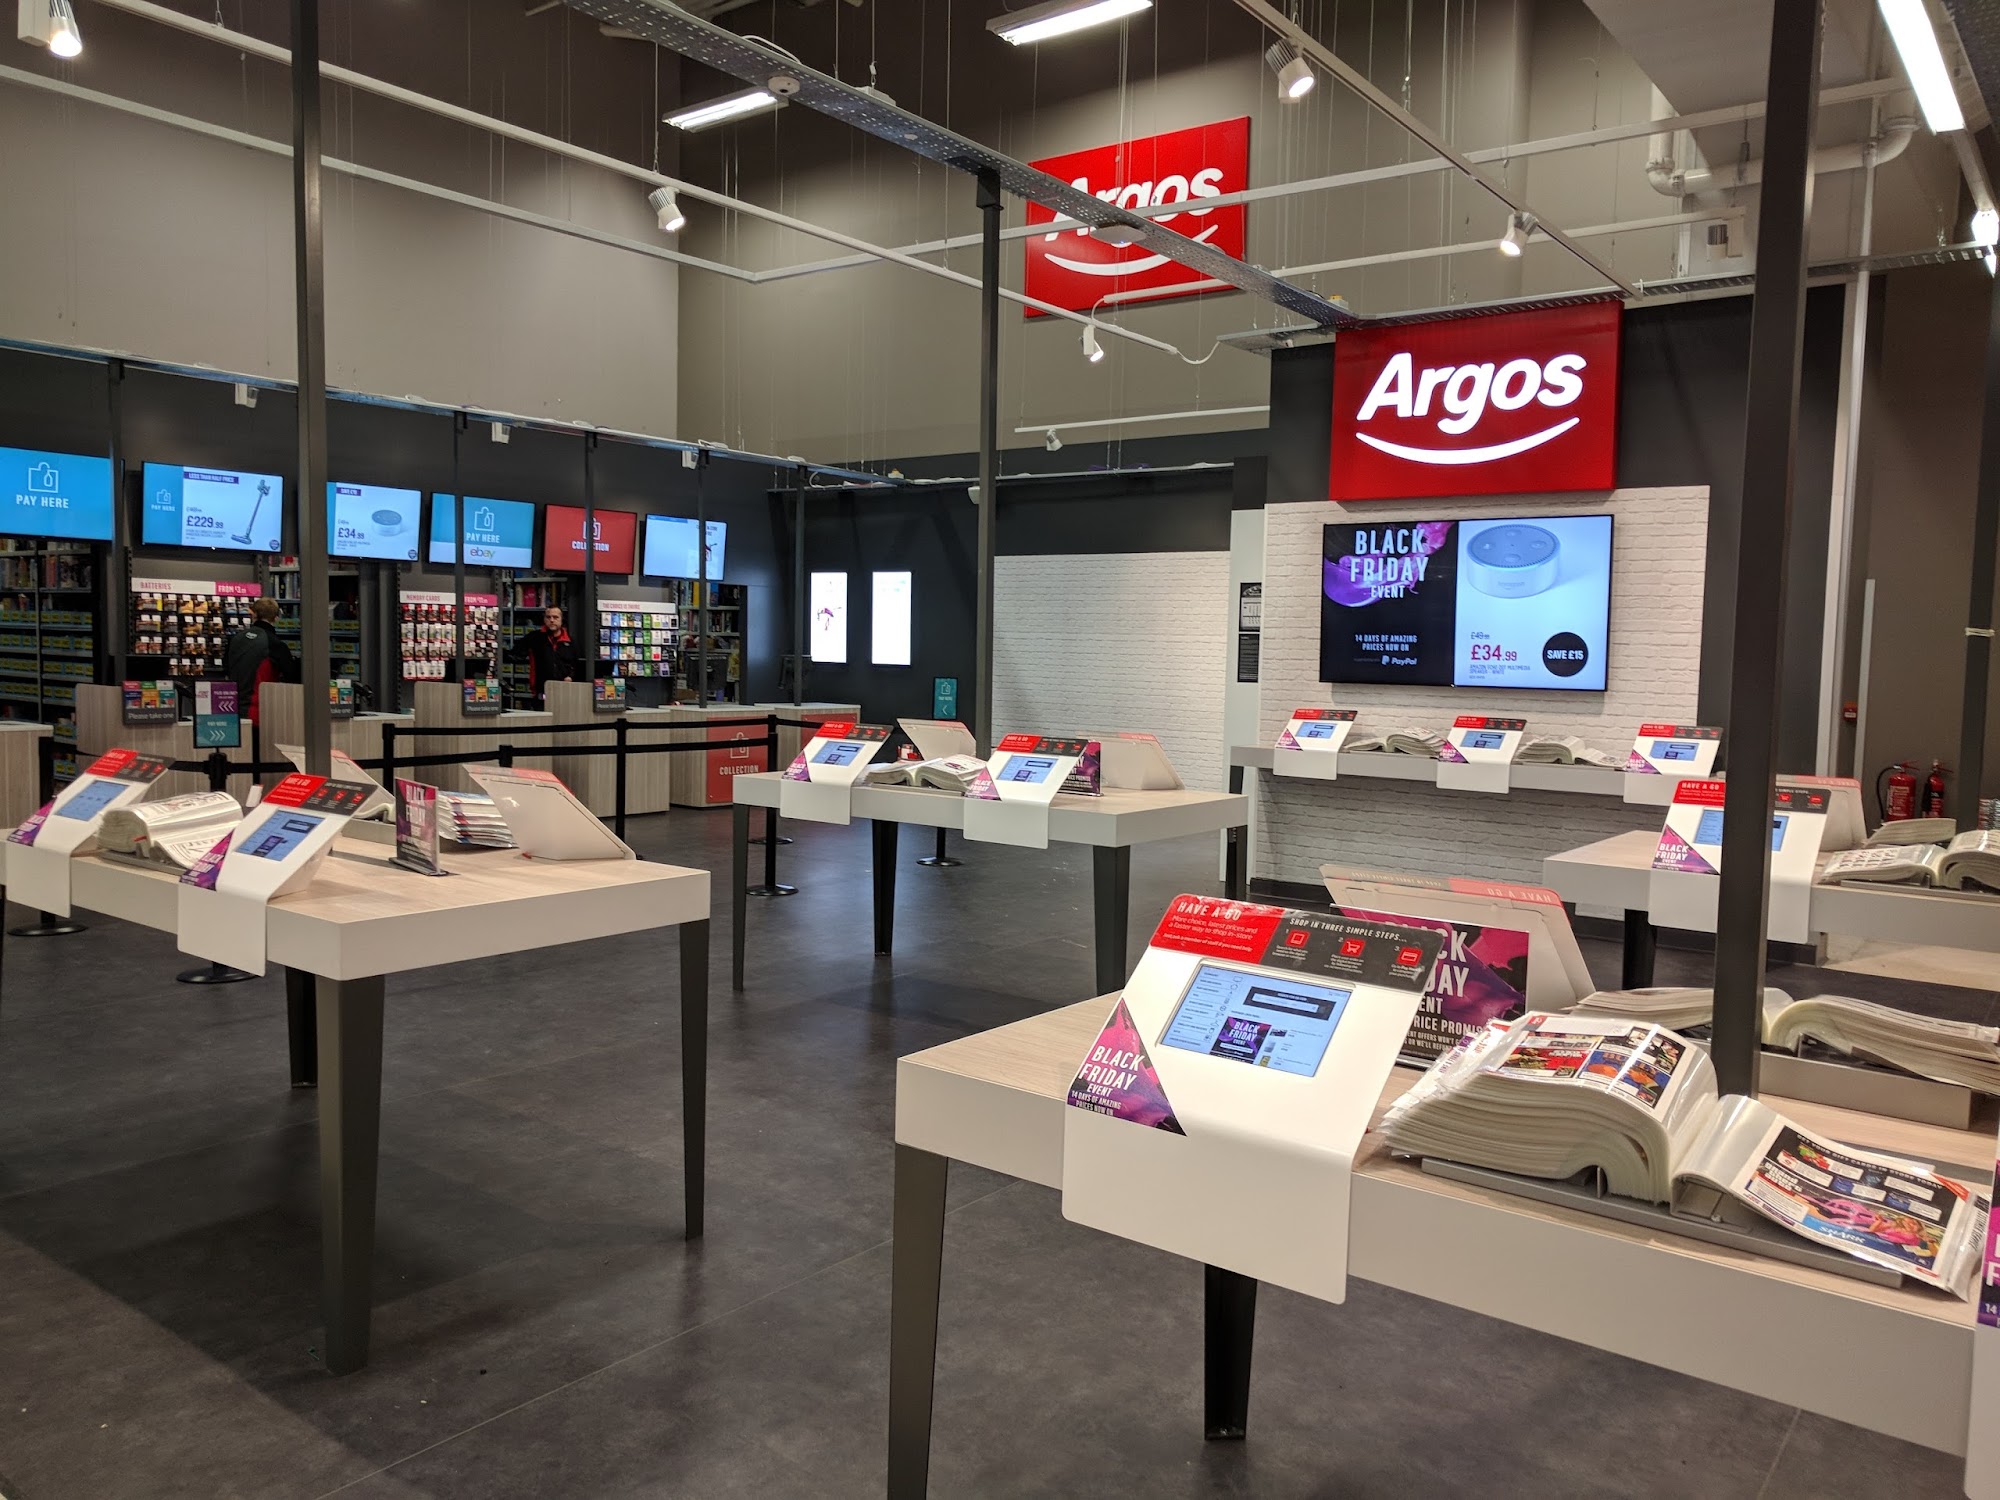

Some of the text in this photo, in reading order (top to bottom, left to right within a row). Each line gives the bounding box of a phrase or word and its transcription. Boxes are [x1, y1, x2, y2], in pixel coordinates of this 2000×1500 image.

[1356, 352, 1587, 434] Argos
[16, 495, 69, 509] PAY HERE
[186, 515, 224, 530] £229.99
[338, 527, 365, 540] £34.99
[466, 532, 500, 543] PAY HERE
[572, 540, 610, 552] COLLTION
[1355, 528, 1426, 555] BLACK
[470, 547, 495, 559] ebay
[1350, 556, 1429, 582] FRIDAY
[140, 581, 172, 590] BATTERIES
[218, 585, 234, 594] FROM
[1370, 585, 1405, 600] EVENT
[1355, 634, 1418, 643] 14 DAYS OF AMAZING
[1362, 643, 1410, 652] PRICES NOW ON
[1471, 644, 1517, 661] £34.99
[1391, 657, 1418, 666] PayPal
[1547, 650, 1584, 660] SAVE £15
[128, 712, 148, 720] Please
[719, 764, 759, 776] COLLECTION
[405, 784, 425, 805] BLACK
[405, 804, 426, 827] FRIDAY
[1659, 843, 1689, 853] BLACK
[1655, 850, 1688, 861] FRIDAY
[1177, 901, 1242, 921] HAVE A GO
[1172, 915, 1188, 924] More
[1187, 916, 1207, 927] choice,
[1208, 920, 1225, 929] latest
[1225, 923, 1245, 933] prices
[1173, 922, 1191, 930] faster
[1191, 926, 1204, 934] way
[1212, 928, 1228, 937] shop
[1289, 918, 1309, 927] SHOP
[1310, 921, 1320, 929] IN
[1321, 922, 1344, 933] THREE
[1345, 926, 1374, 937] SIMPLE
[1418, 995, 1444, 1015] ENT
[1234, 1021, 1260, 1034] BLACK
[1414, 1015, 1484, 1035] RICE PROMIS
[1229, 1029, 1258, 1042] FRIDAY
[1417, 1032, 1437, 1042] OFFERS
[1437, 1035, 1455, 1045] WON'T
[1416, 1040, 1432, 1049] WE'LL
[1091, 1045, 1146, 1072] BLACK
[1078, 1062, 1137, 1091] FRIDAY
[1086, 1083, 1113, 1098] EVENT
[1071, 1090, 1122, 1110] 14 DAYS OF AMAZING
[1075, 1100, 1093, 1111] PRICES
[1810, 1142, 1831, 1155] YOUR
[1831, 1151, 1849, 1163] GIFT
[1851, 1158, 1877, 1170] CARDS
[1888, 1169, 1915, 1180] STORE
[1915, 1177, 1943, 1190] TODAY
[1819, 1226, 1866, 1244] SHARK
[1985, 1302, 1998, 1315] 14
